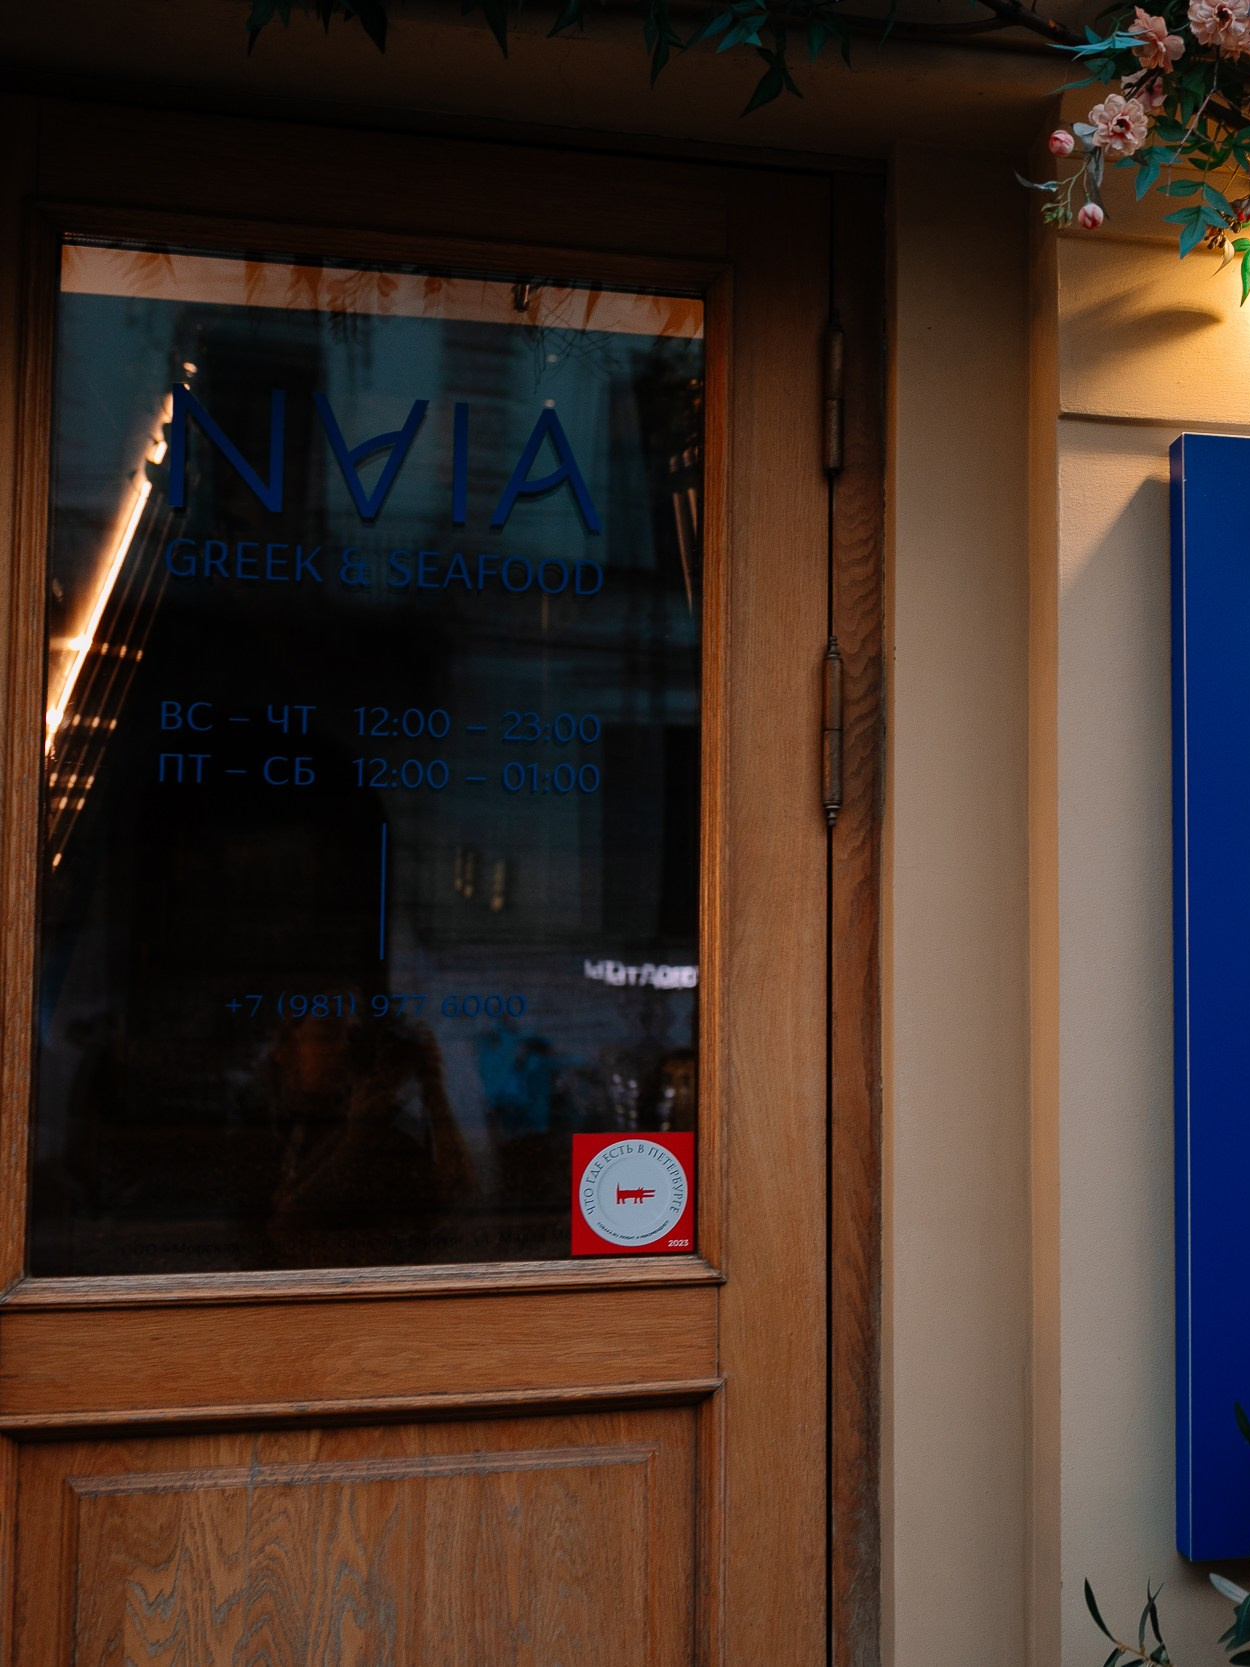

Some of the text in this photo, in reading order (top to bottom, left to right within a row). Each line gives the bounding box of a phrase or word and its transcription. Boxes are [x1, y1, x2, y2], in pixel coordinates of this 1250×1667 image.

[164, 538, 604, 597] GREEK & SEAFOOD
[160, 701, 213, 731] ВС
[266, 704, 316, 734] ЧТ
[352, 706, 450, 738] 12:00
[501, 711, 602, 744] 23:00
[158, 753, 212, 783] ПТ
[264, 756, 315, 785] СБ
[352, 757, 449, 789] 12:00
[502, 761, 600, 793] 01:00
[224, 992, 527, 1018] +7 (981) 977 6000
[583, 1144, 684, 1215] ЧТО ГДЕ ЕСТЬ В ПЕТЕРБУРГЕ
